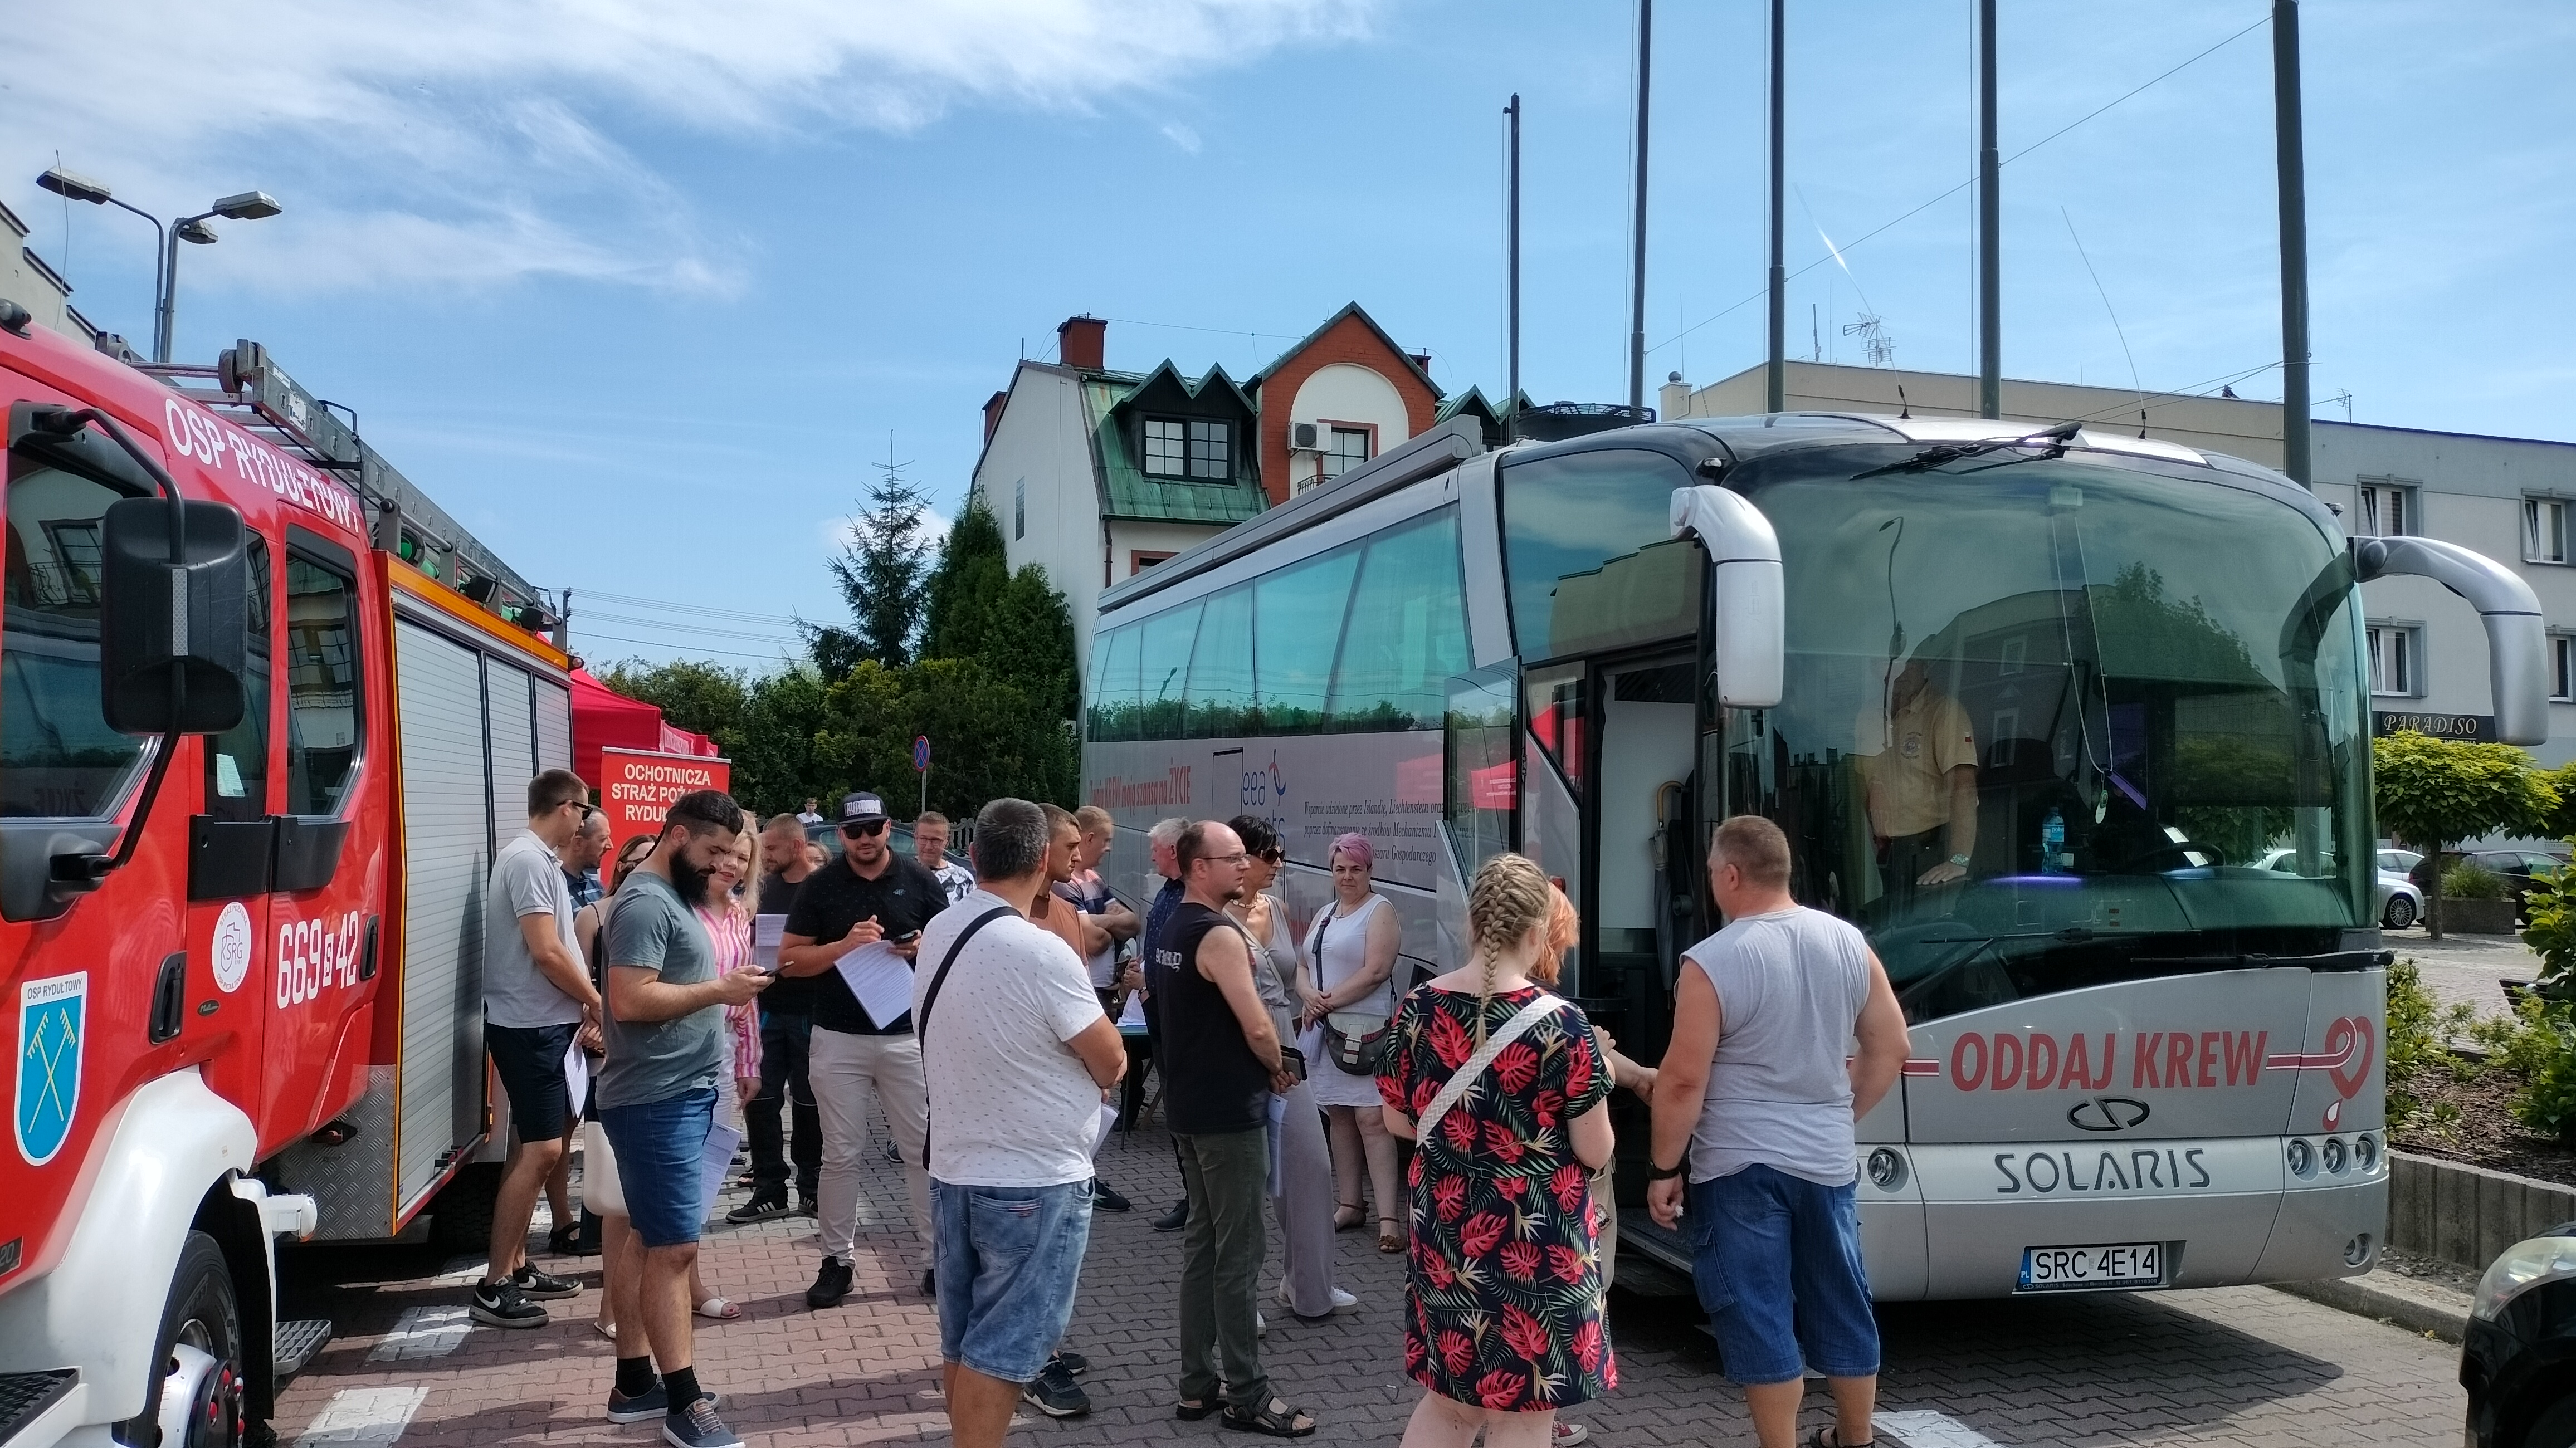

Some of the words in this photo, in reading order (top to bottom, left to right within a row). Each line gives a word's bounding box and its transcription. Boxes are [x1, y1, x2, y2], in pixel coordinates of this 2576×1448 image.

[166, 398, 225, 469] OSP
[2384, 715, 2477, 735] PARADISO
[624, 763, 711, 786] OCHOTNICZA
[1104, 775, 1121, 809] KREW
[1159, 780, 1168, 805] na
[1168, 756, 1191, 805] ŻYCIE
[611, 782, 656, 803] STRAŻ
[1243, 771, 1266, 806] eea
[625, 804, 668, 823] RYDUŁ
[1304, 801, 1325, 818] Wsparcie
[1325, 800, 1348, 815] udzielone
[1348, 804, 1363, 818] przez
[1364, 799, 1388, 818] Islandię,
[1389, 798, 1428, 815] Liechtenstein
[1304, 825, 1321, 838] poprzez
[1321, 821, 1360, 838] dofinansowanie
[1361, 825, 1367, 836] ze
[1368, 821, 1392, 838] środków
[1393, 821, 1432, 838] Mechanizmu
[1391, 844, 1437, 867] Gospodarczego
[222, 942, 243, 961] KSRG
[27, 986, 42, 1000] OSP
[43, 978, 82, 997] RYDUŁTOWY
[1950, 1031, 2116, 1092] ODDAJ
[2131, 1030, 2269, 1089] KREW
[1994, 1148, 2211, 1194] SOLARIS
[2021, 1270, 2029, 1279] PL
[2036, 1250, 2088, 1280] SRC
[2097, 1248, 2154, 1277] 4E14
